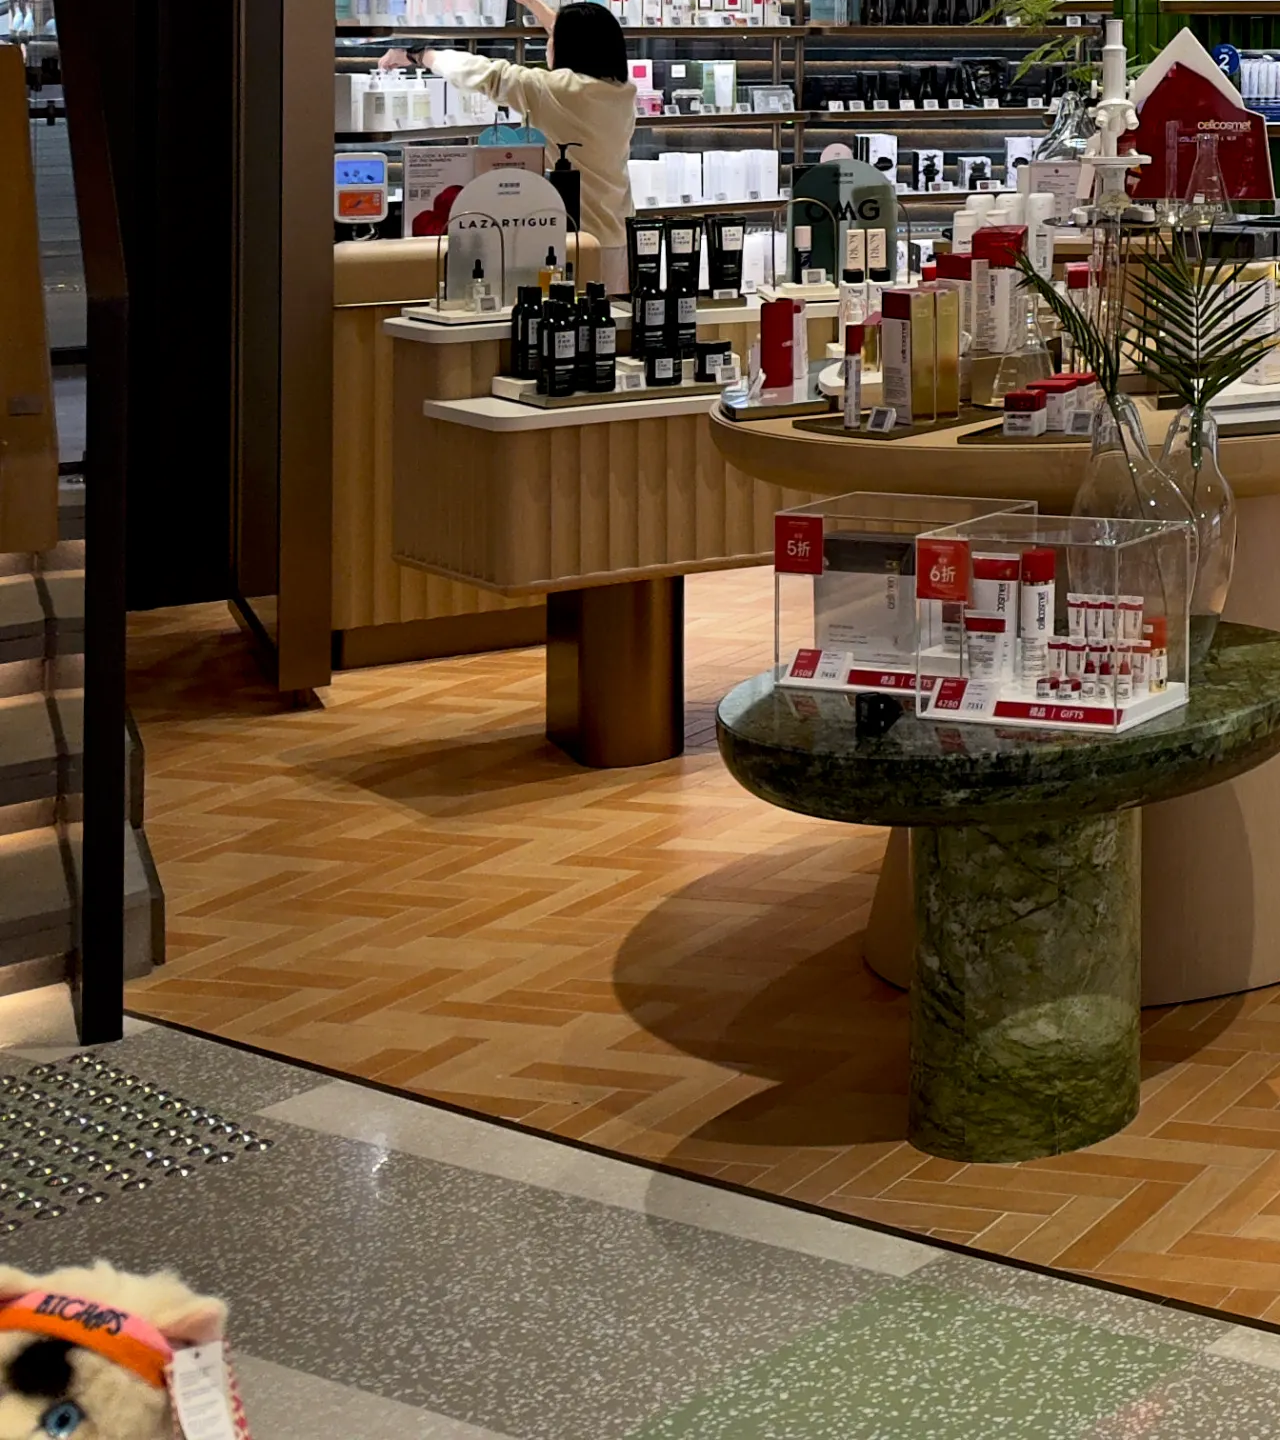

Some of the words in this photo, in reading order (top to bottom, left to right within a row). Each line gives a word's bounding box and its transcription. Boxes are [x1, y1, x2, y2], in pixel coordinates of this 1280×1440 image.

[1218, 54, 1230, 70] 2
[1197, 119, 1252, 131] cellcosmet
[804, 198, 880, 223] OMG
[458, 216, 557, 230] LAZARTIGUE
[786, 539, 811, 558] 5折
[929, 564, 956, 583] 6折
[1060, 709, 1085, 719] GIFTS
